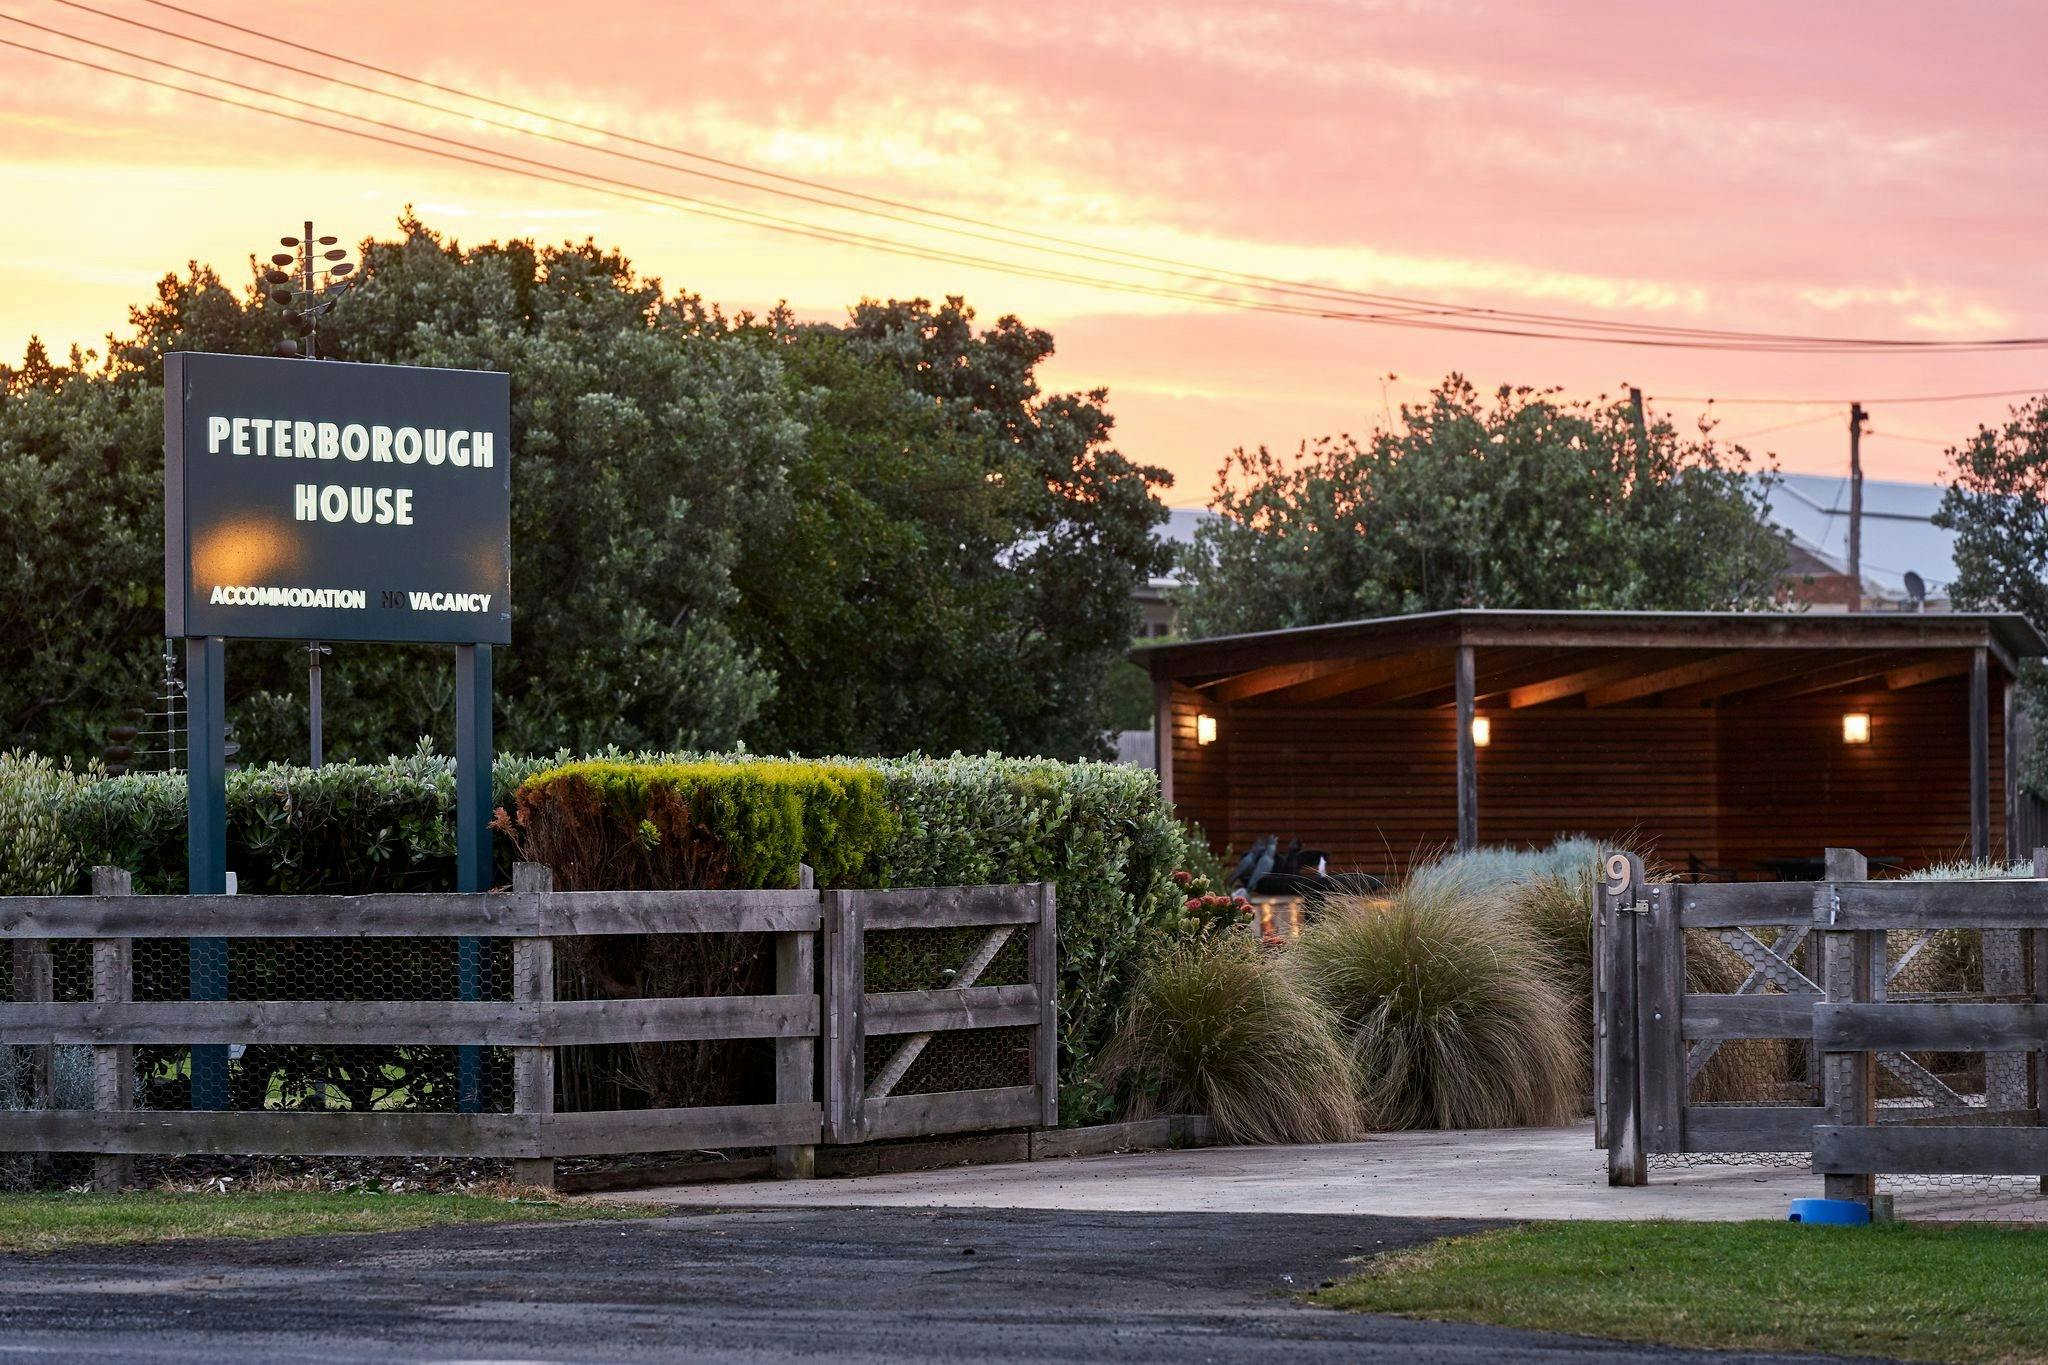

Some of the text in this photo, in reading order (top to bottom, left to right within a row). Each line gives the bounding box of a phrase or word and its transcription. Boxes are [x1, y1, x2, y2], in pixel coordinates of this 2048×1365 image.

[208, 416, 495, 468] PETERBOROUGH
[295, 484, 414, 526] HOUSE
[209, 585, 492, 613] ACCOMMODATION NO VACANCY
[1606, 854, 1631, 896] 9
